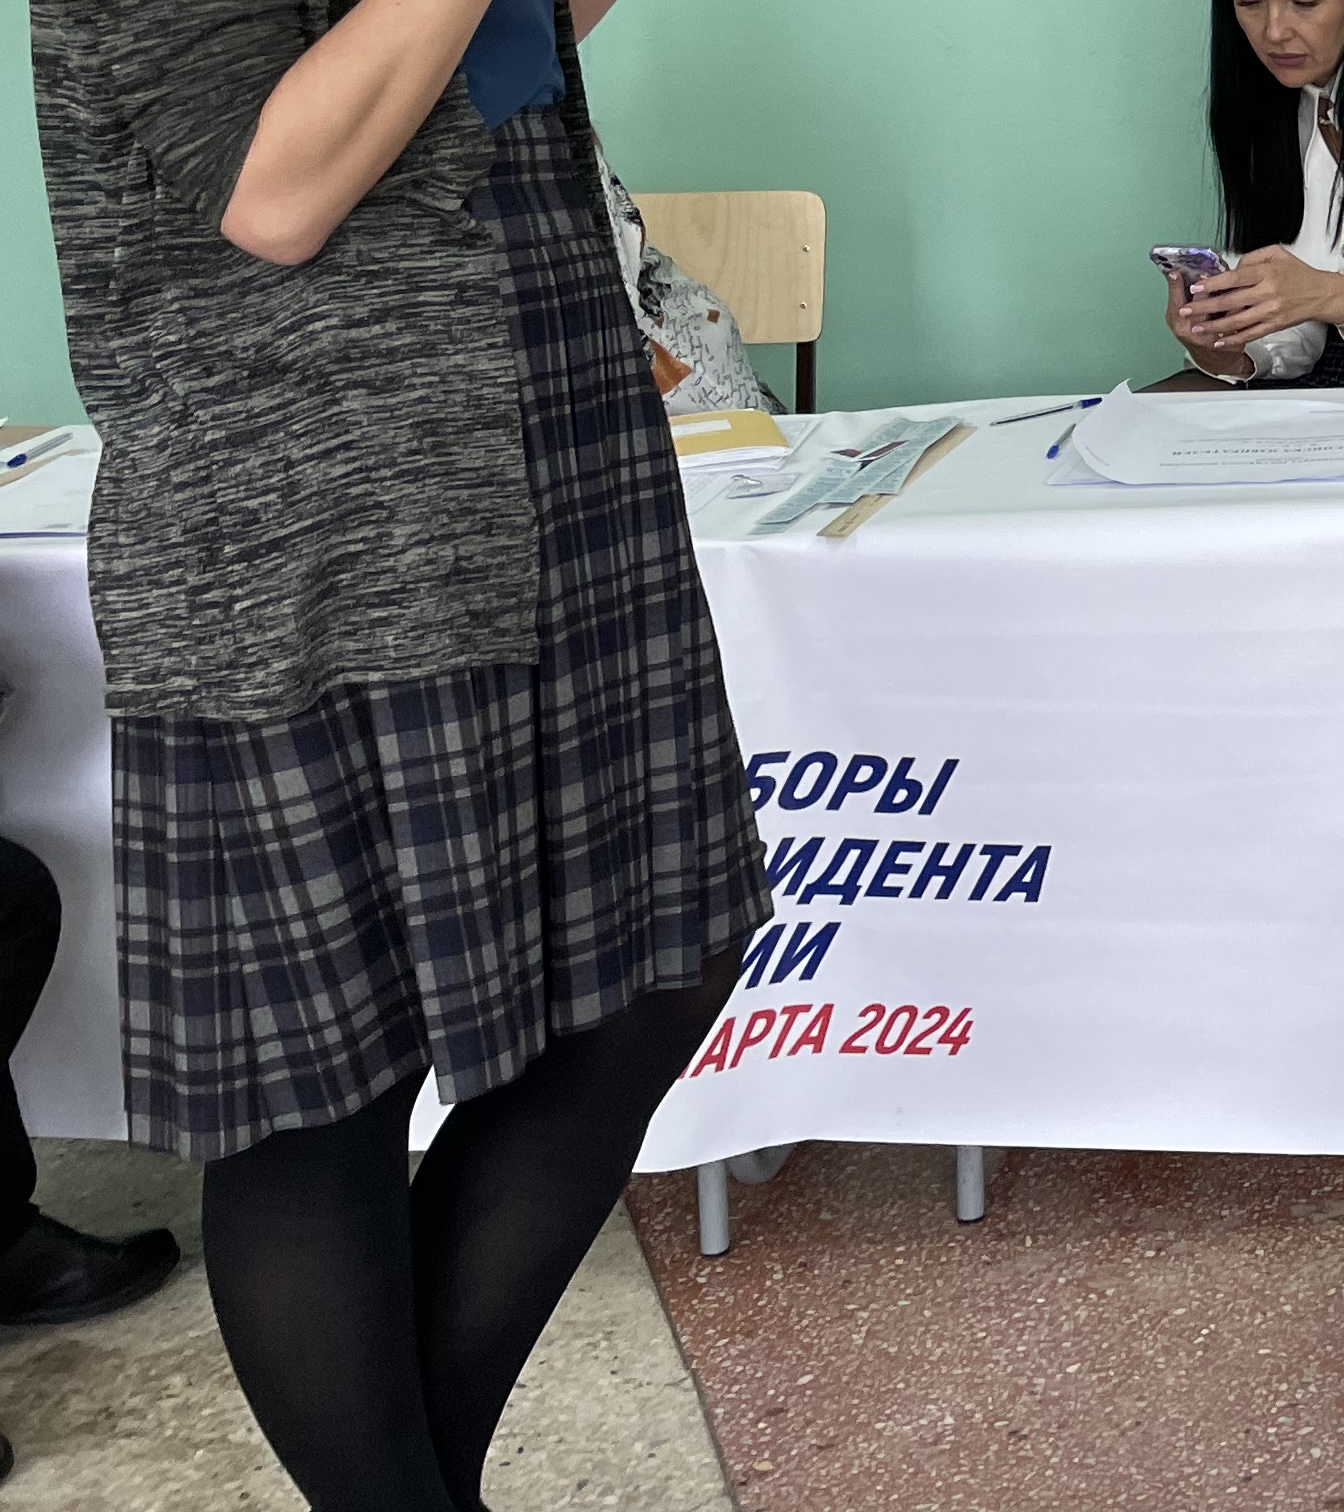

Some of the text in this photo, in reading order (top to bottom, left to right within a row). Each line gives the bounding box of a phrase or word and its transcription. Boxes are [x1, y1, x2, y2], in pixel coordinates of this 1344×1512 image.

[743, 749, 960, 816] БОРЫ
[765, 835, 1052, 907] ИДЕНТА
[678, 1002, 974, 1080] АРТА 2024
